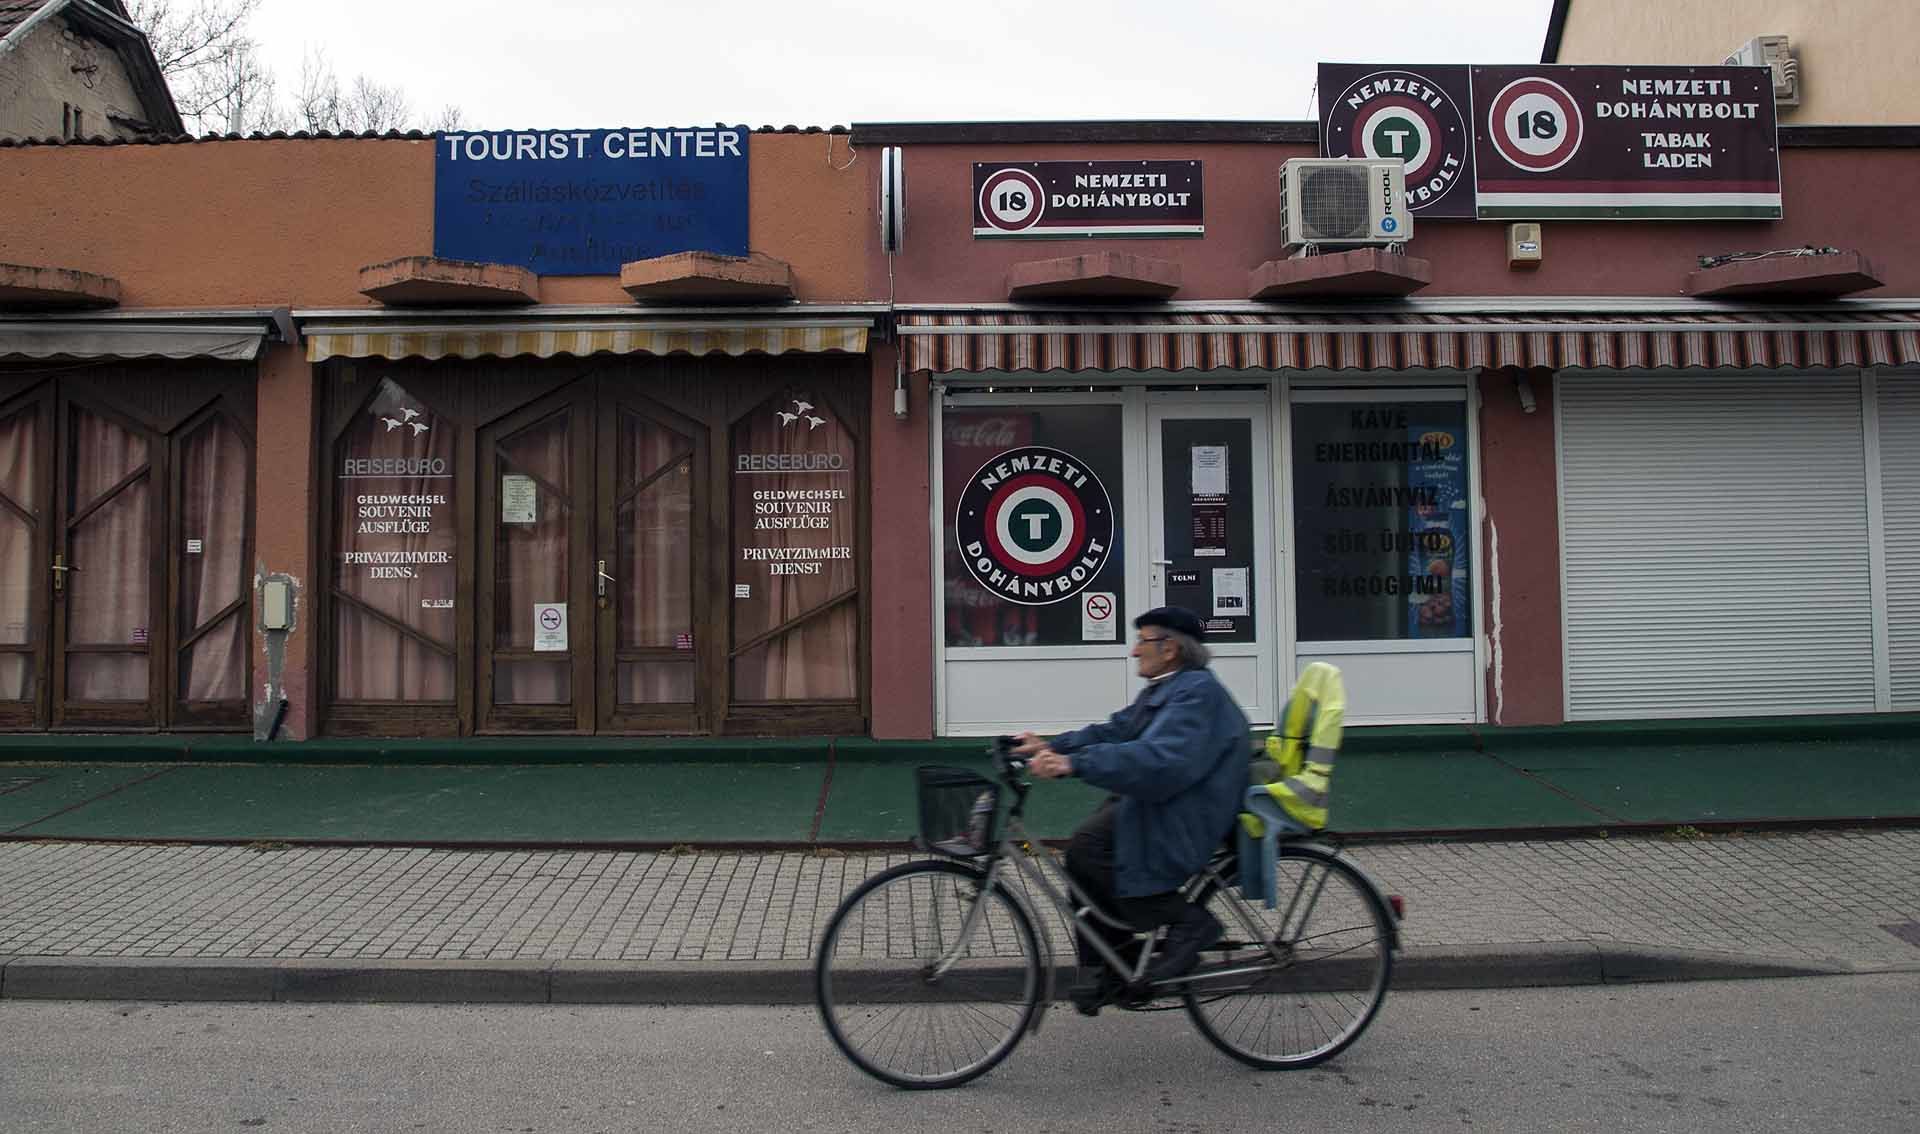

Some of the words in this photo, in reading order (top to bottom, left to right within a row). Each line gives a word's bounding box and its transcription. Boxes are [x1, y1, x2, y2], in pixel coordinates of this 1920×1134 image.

[1347, 78, 1442, 110] NEMZETI
[1623, 79, 1730, 96] NEMZETI
[1596, 99, 1759, 119] DOHÁNYBOLT
[1517, 110, 1558, 140] 18
[445, 133, 591, 161] TOURIST
[603, 131, 741, 158] CENTER
[1383, 130, 1410, 154] T
[1641, 133, 1711, 148] TABAK
[1643, 153, 1712, 168] LADEN
[1075, 174, 1167, 189] NEMZETI
[1382, 167, 1392, 215] RCOOL
[999, 191, 1027, 212] 18
[1052, 190, 1191, 208] DOHÁNYBOLT
[981, 455, 1087, 491] NEMZETI
[357, 495, 446, 504] GELDWECHSEL
[753, 490, 845, 500] GELDWECHSEL
[359, 506, 432, 518] SOUVENIR
[755, 502, 832, 514] SOUVENIR
[358, 519, 430, 533] AUSFLÜGE
[754, 515, 829, 529] AUSFLÜGE
[1021, 513, 1050, 540] T
[344, 551, 453, 564] PRIVATZIMMER-
[743, 547, 851, 560] PRIVATZIMMER
[370, 567, 419, 579] DIENS
[770, 563, 822, 575] DIENST
[967, 537, 1104, 598] DOHÁNYBOLT
